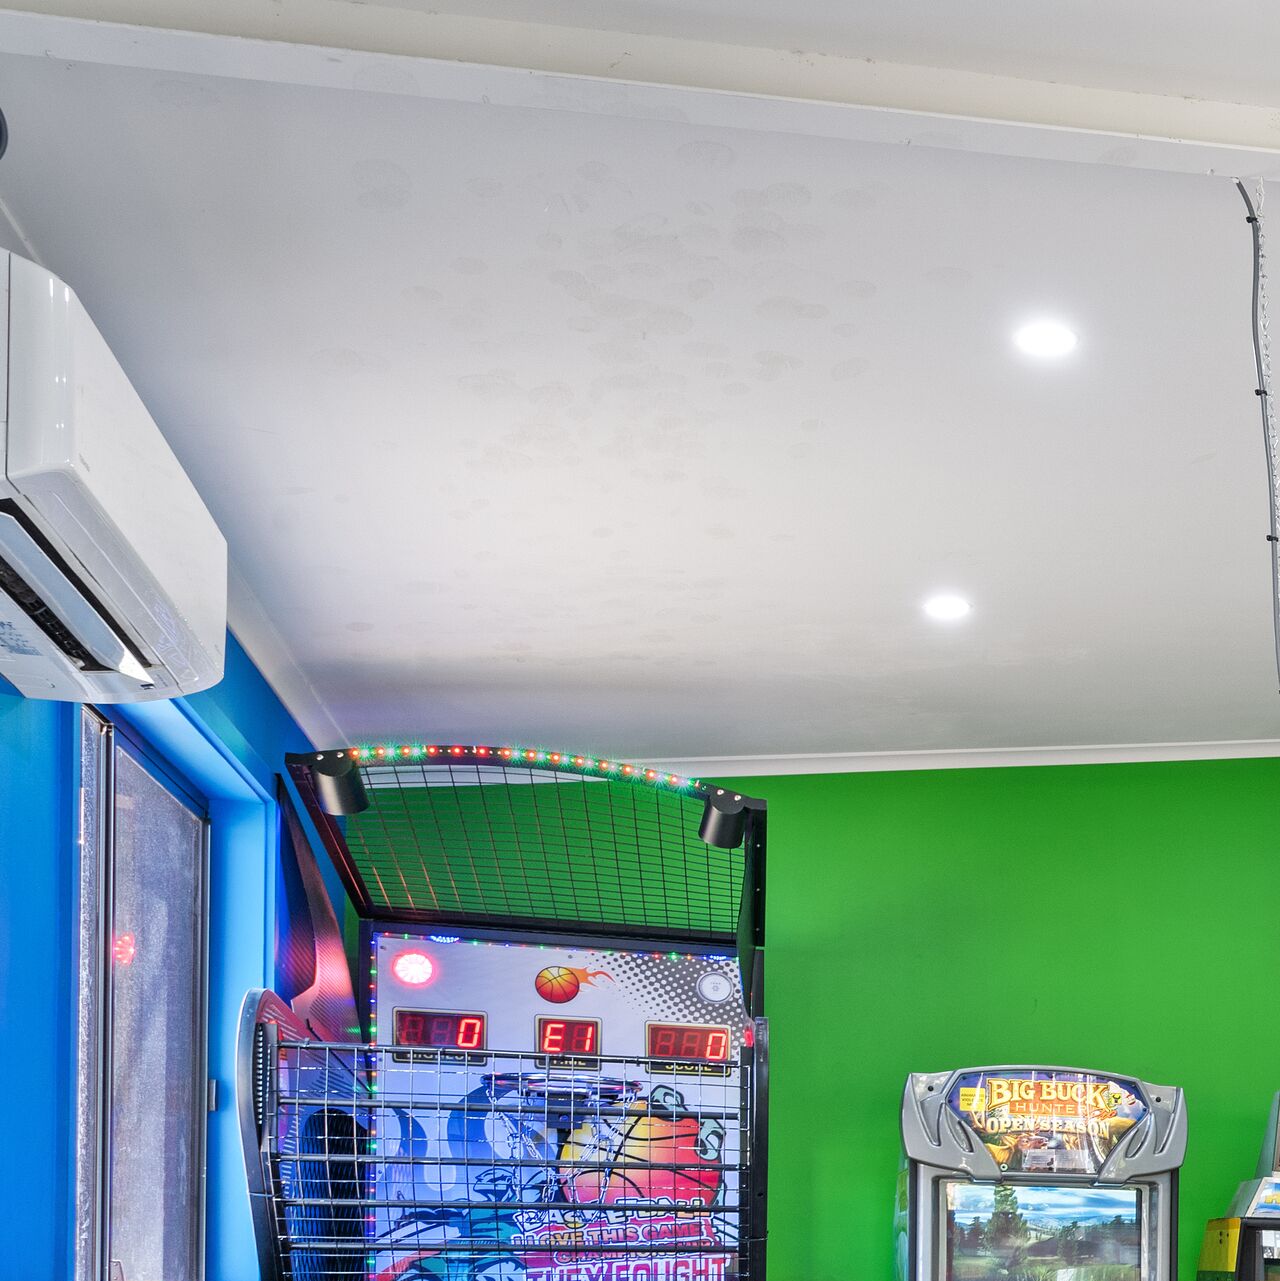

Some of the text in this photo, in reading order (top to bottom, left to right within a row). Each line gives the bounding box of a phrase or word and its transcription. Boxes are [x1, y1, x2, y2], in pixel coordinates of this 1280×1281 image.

[988, 1078, 1036, 1105] BIG
[1039, 1080, 1110, 1110] BUCK
[1015, 1102, 1087, 1114] HUNTER
[986, 1116, 1110, 1139] OPEN SEASON
[588, 1226, 638, 1246] THIS
